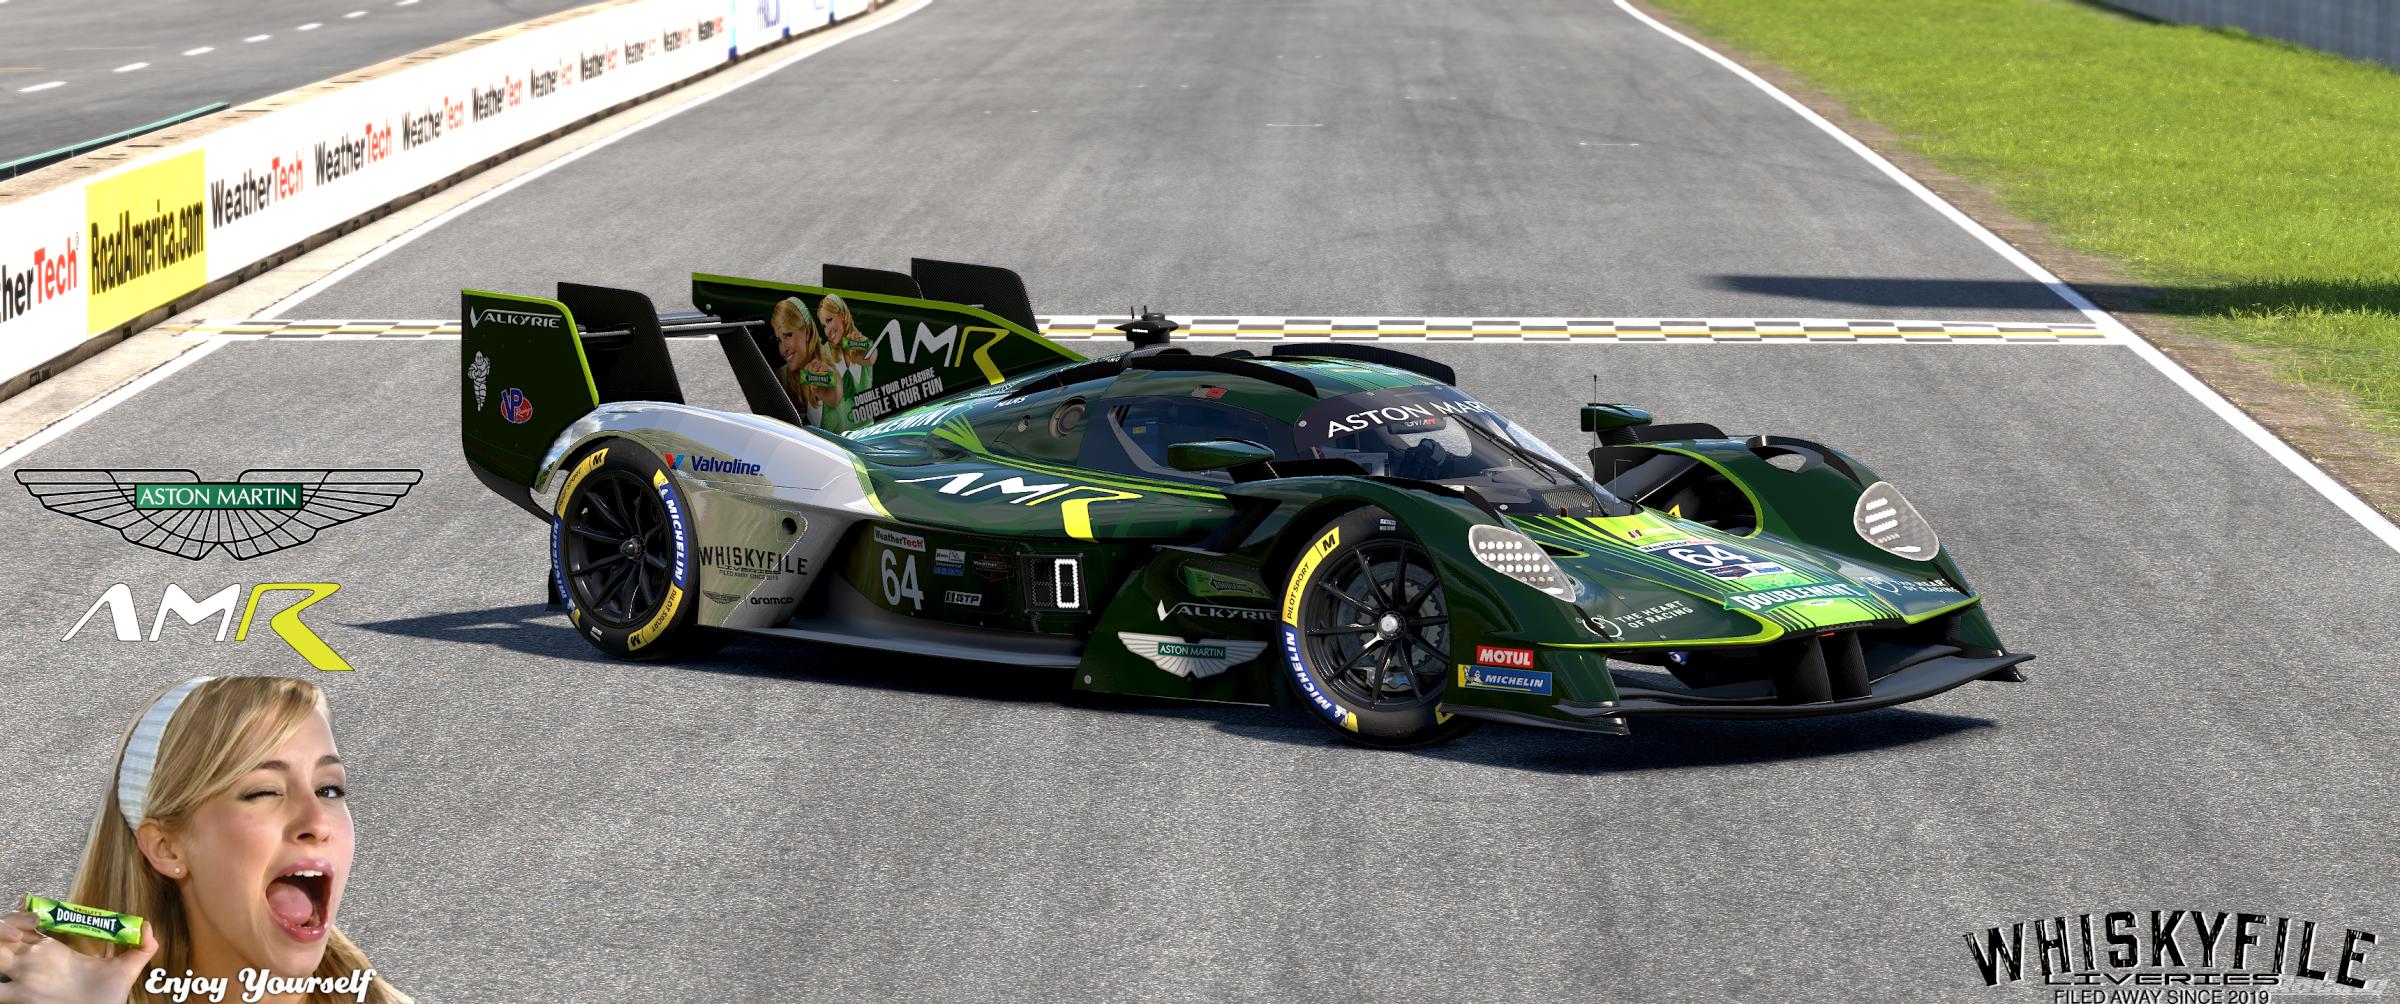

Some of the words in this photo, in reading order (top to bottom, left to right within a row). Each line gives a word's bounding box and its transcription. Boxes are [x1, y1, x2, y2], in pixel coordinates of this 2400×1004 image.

[314, 120, 392, 186] WeatherTech
[210, 153, 304, 229] WeatherTech
[90, 199, 204, 295] RoadAmerica.com
[469, 306, 563, 329] VALKYRIE
[864, 318, 1010, 386] AMR
[851, 396, 892, 424] DOUBLE
[892, 386, 921, 409] YOUR
[921, 376, 944, 399] FUN
[854, 387, 880, 407] DOUBLE
[880, 380, 900, 397] YOUR
[900, 367, 935, 389] PLEASURE
[501, 387, 525, 423] VP
[1327, 403, 1434, 439] ASTON
[592, 453, 604, 465] M
[691, 454, 761, 476] Valvoline
[893, 472, 1144, 544] AMR
[665, 498, 685, 581] MICHELIN
[875, 529, 924, 549] WeatherTech
[1321, 534, 1336, 551] M
[699, 545, 808, 575] WHISKYFILE
[1667, 545, 1755, 568] 64
[881, 548, 924, 611] 64
[1054, 558, 1080, 609] 0
[1287, 596, 1298, 620] PILOT
[1293, 562, 1310, 593] SPORT
[665, 589, 677, 610] PILOT
[750, 596, 794, 606] aramco
[1157, 599, 1279, 622] VALKYRIE
[1729, 583, 1866, 611] DOUBLEMINT
[651, 607, 669, 633] SPORT
[1614, 612, 1642, 623] THE
[1642, 600, 1684, 616] HEART
[1627, 620, 1645, 629] OF
[1646, 606, 1694, 624] RACING
[630, 634, 642, 646] M
[1159, 643, 1189, 655] ASTON
[1190, 645, 1224, 658] MARTIN
[1285, 631, 1331, 711] MICHELIN
[1479, 649, 1531, 666] MOTUL
[1485, 674, 1544, 688] MICHELIN
